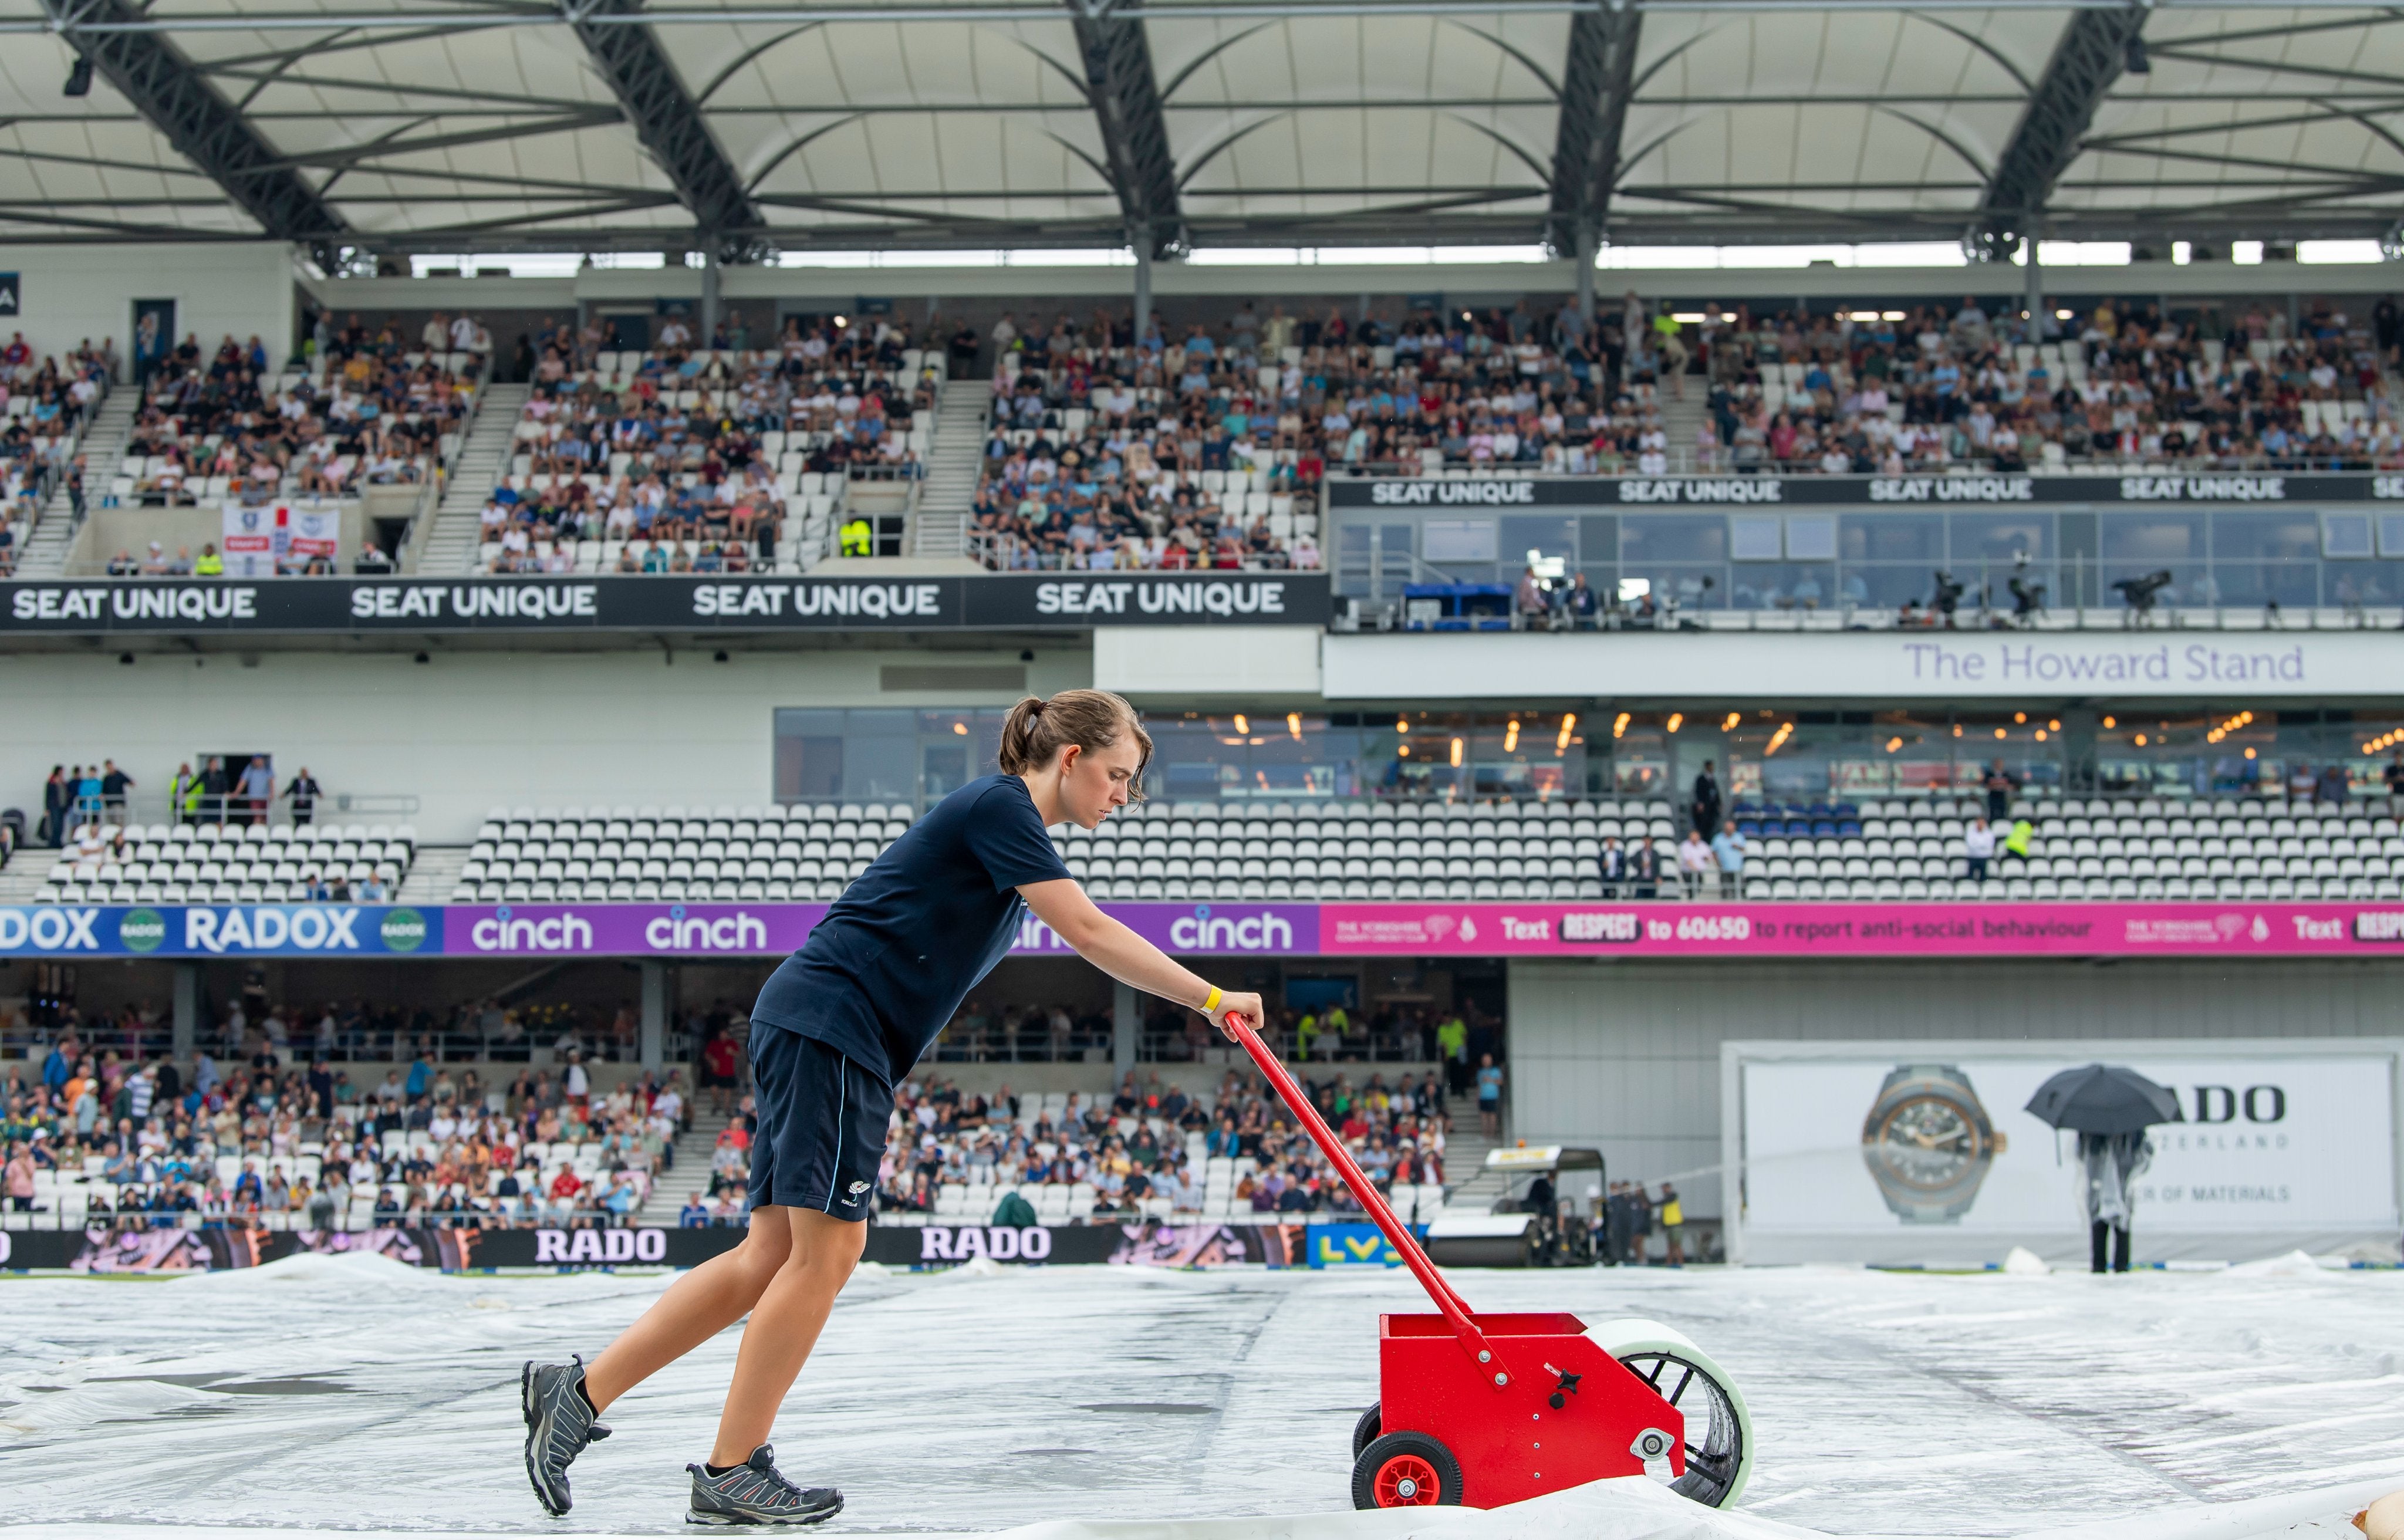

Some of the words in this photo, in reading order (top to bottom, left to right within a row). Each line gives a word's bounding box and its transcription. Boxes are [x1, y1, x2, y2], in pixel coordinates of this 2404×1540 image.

[1372, 483, 1435, 504] SEAT
[1437, 482, 1534, 505] UNIQUE
[1619, 481, 1682, 502] SEAT
[1685, 481, 1782, 504] UNIQUE
[1869, 479, 1933, 501] SEAT
[1936, 479, 2032, 502] UNIQUE
[2120, 478, 2184, 499] SEAT
[2187, 478, 2285, 501] UNIQUE
[13, 589, 107, 619] SEAT
[113, 587, 256, 622] UNIQUE
[352, 587, 447, 617] SEAT
[452, 586, 597, 620] UNIQUE
[693, 585, 789, 616] SEAT
[794, 585, 939, 618] UNIQUE
[1036, 583, 1133, 613] SEAT
[1137, 582, 1284, 616] UNIQUE
[1904, 644, 1986, 681] The
[2002, 644, 2169, 681] Howard
[2186, 644, 2304, 681] Stand
[120, 924, 165, 938] RADOX
[185, 907, 360, 953] RADOX
[381, 923, 425, 938] RADOX
[472, 906, 593, 950] cinch
[646, 905, 767, 950] cinch
[1170, 904, 1292, 949] cinch
[1500, 916, 1551, 940] Text
[1647, 919, 1672, 940] to
[1676, 916, 1750, 940] 60650
[1755, 921, 1777, 938] to
[1784, 921, 1852, 942] report
[1861, 918, 1974, 938] anti-social
[1983, 918, 2095, 938] behaviour
[2292, 915, 2343, 940] Text
[2161, 1133, 2288, 1151] ZERLAND
[2162, 1186, 2183, 1202] OF
[2192, 1185, 2291, 1202] MATERIALS
[535, 1229, 666, 1262] RADO
[921, 1227, 1051, 1259] RADO
